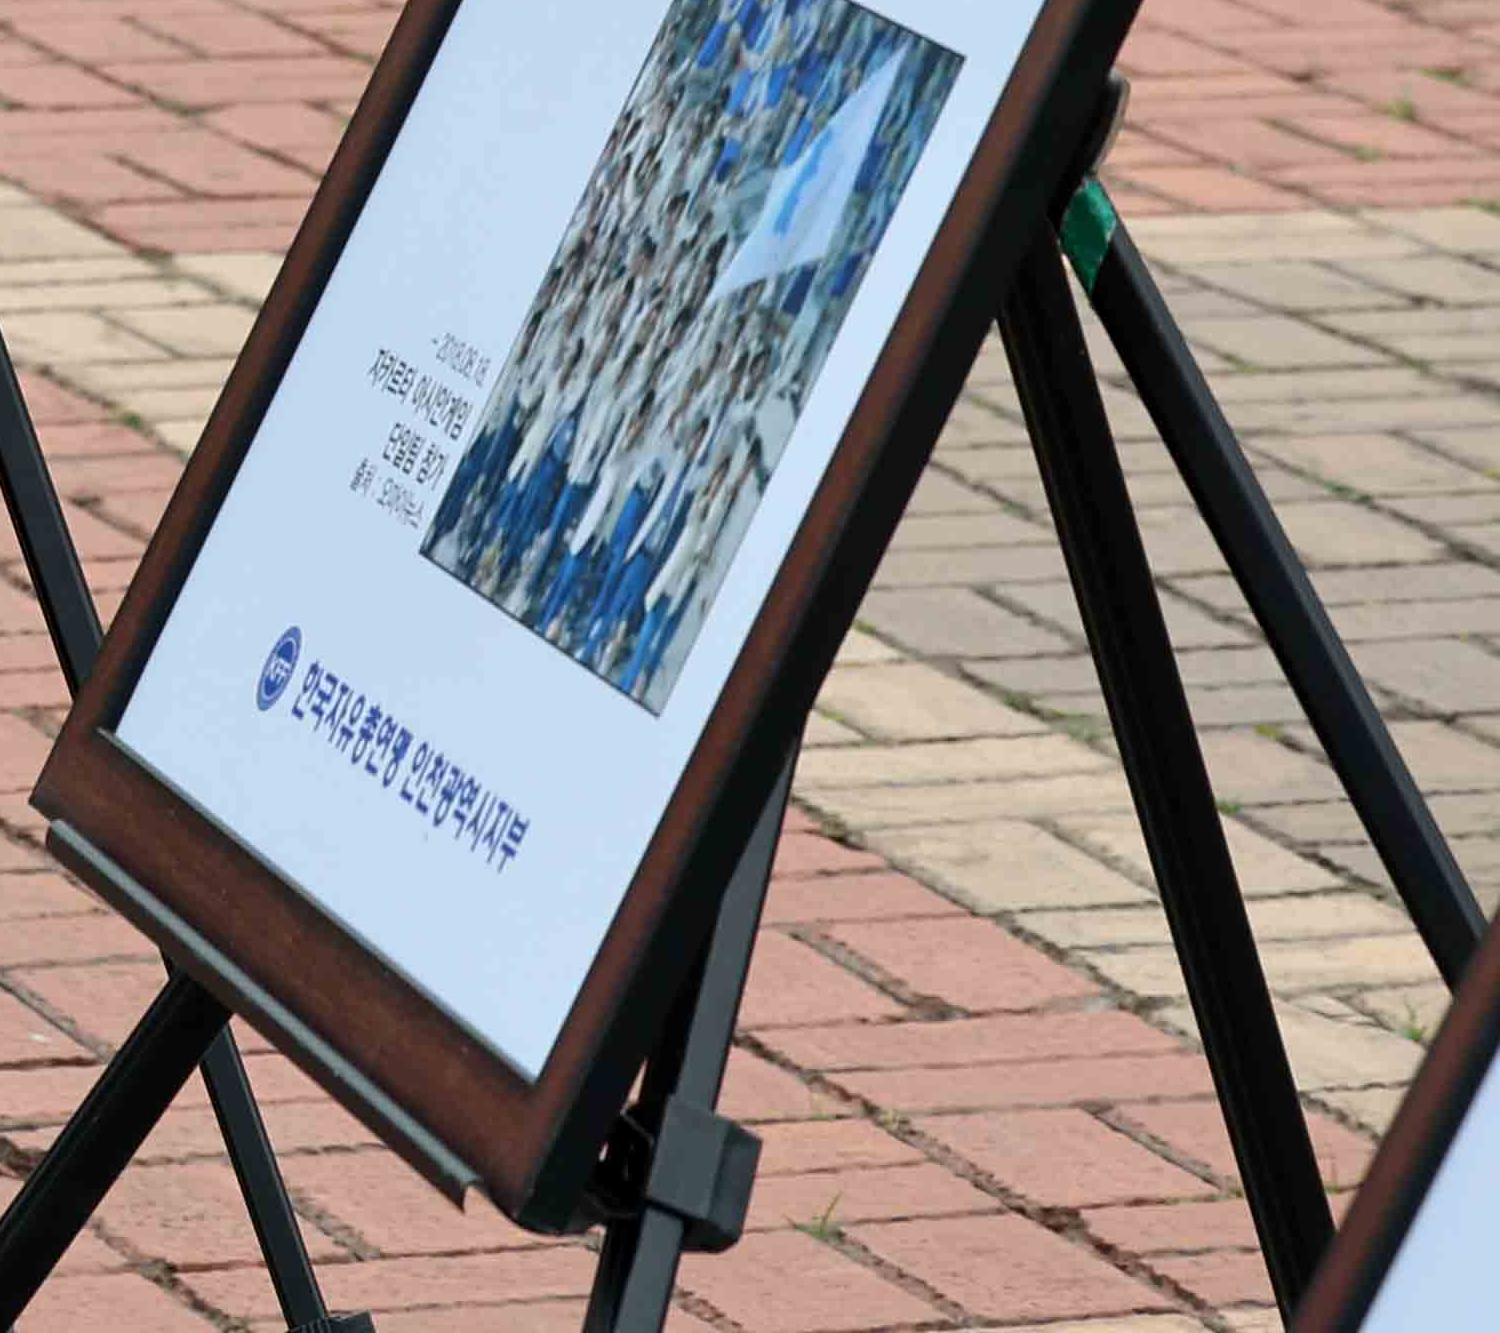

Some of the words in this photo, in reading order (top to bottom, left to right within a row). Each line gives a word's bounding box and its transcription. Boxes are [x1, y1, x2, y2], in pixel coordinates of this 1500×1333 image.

[367, 349, 418, 404] 자카르타
[412, 375, 473, 441] 아시안게임
[383, 423, 425, 475] 단일팀
[415, 442, 449, 491] 참가
[292, 661, 413, 788] 한국자유총연맹
[400, 741, 530, 872] 인천광역시지부
